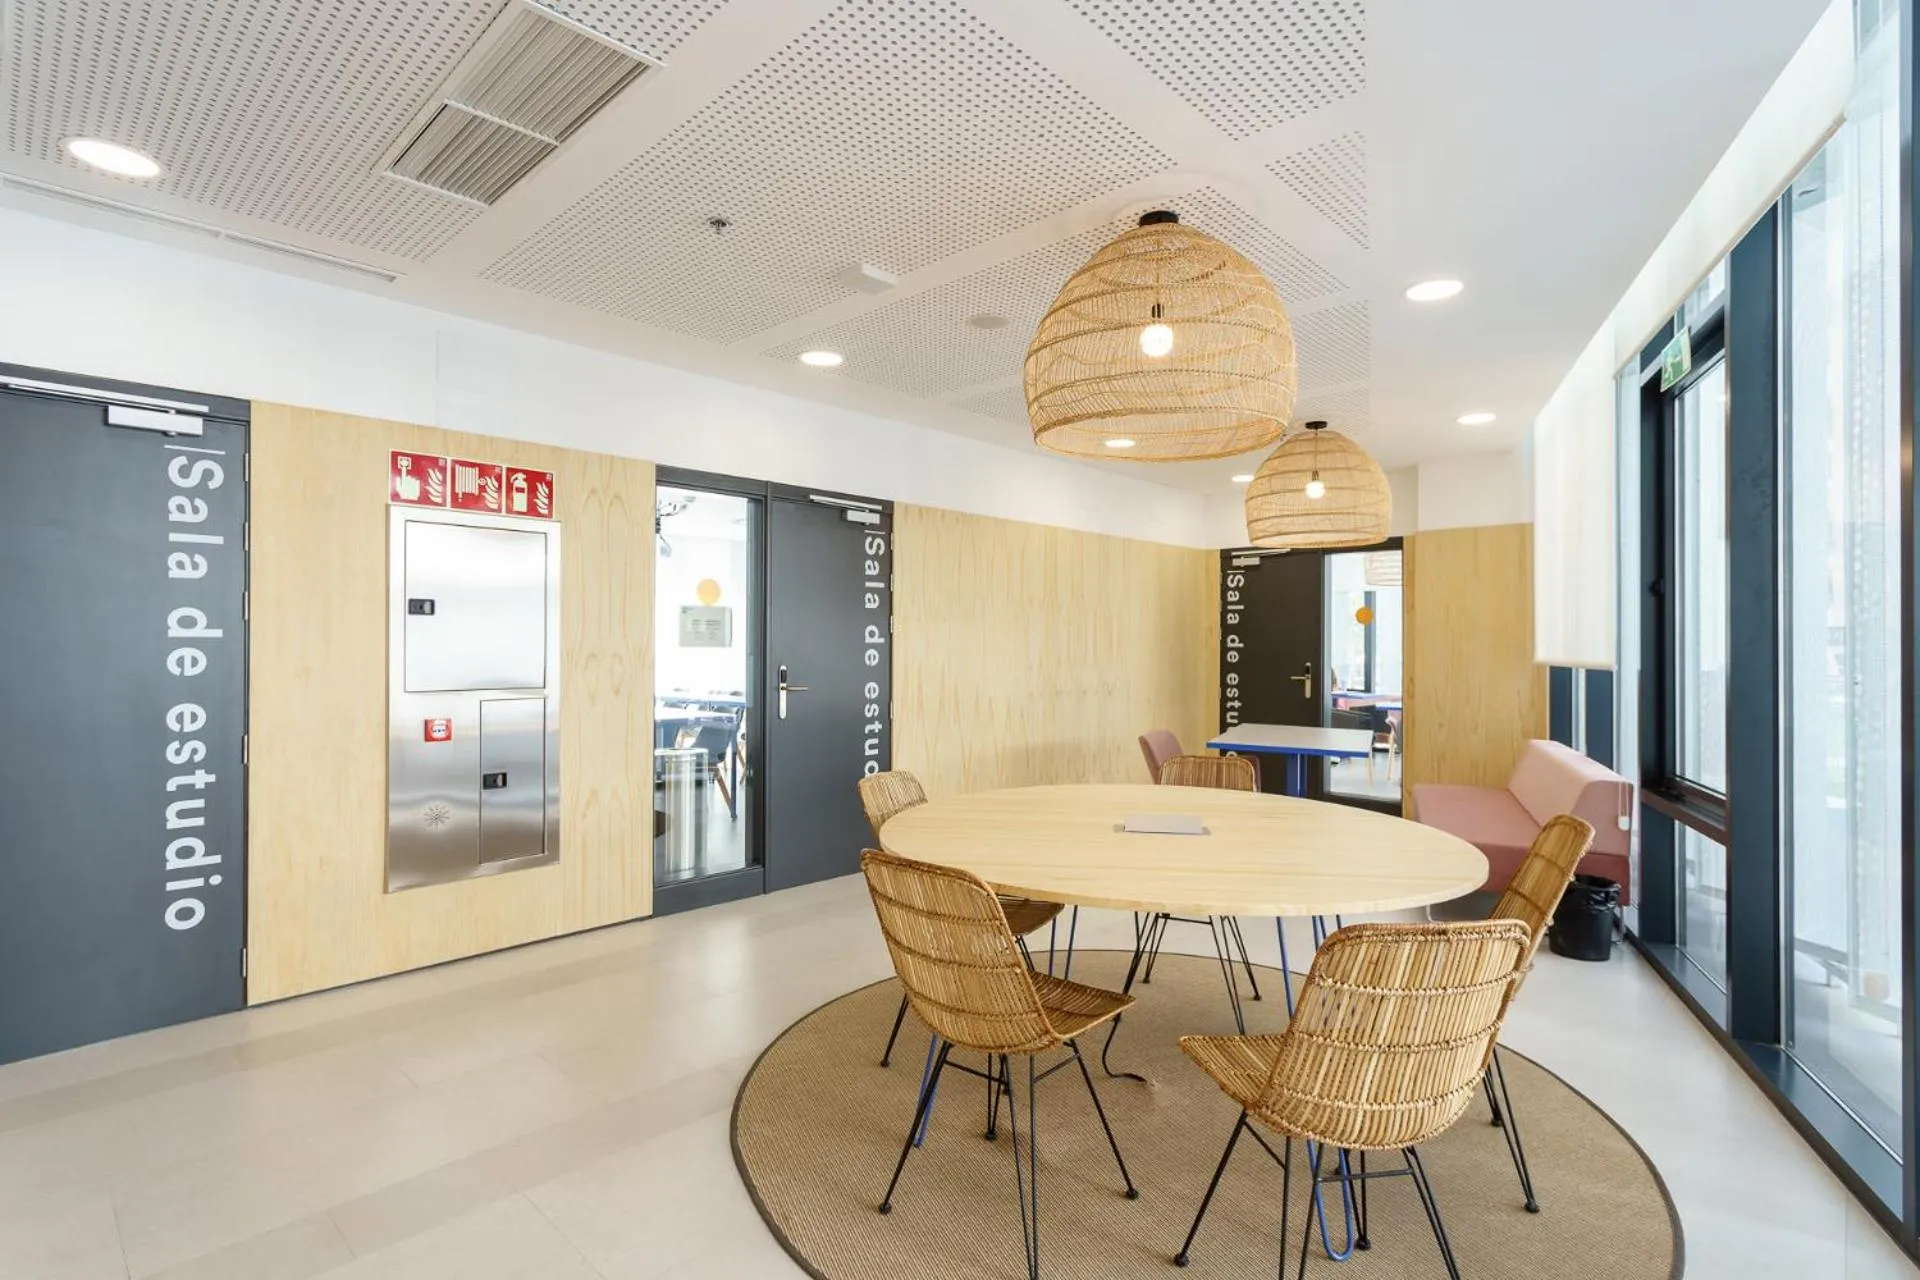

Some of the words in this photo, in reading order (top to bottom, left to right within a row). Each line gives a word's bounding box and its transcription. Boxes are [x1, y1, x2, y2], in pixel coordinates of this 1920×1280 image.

[166, 605, 224, 677] de
[864, 624, 886, 668] de
[1226, 634, 1244, 663] de
[164, 702, 224, 931] estudio
